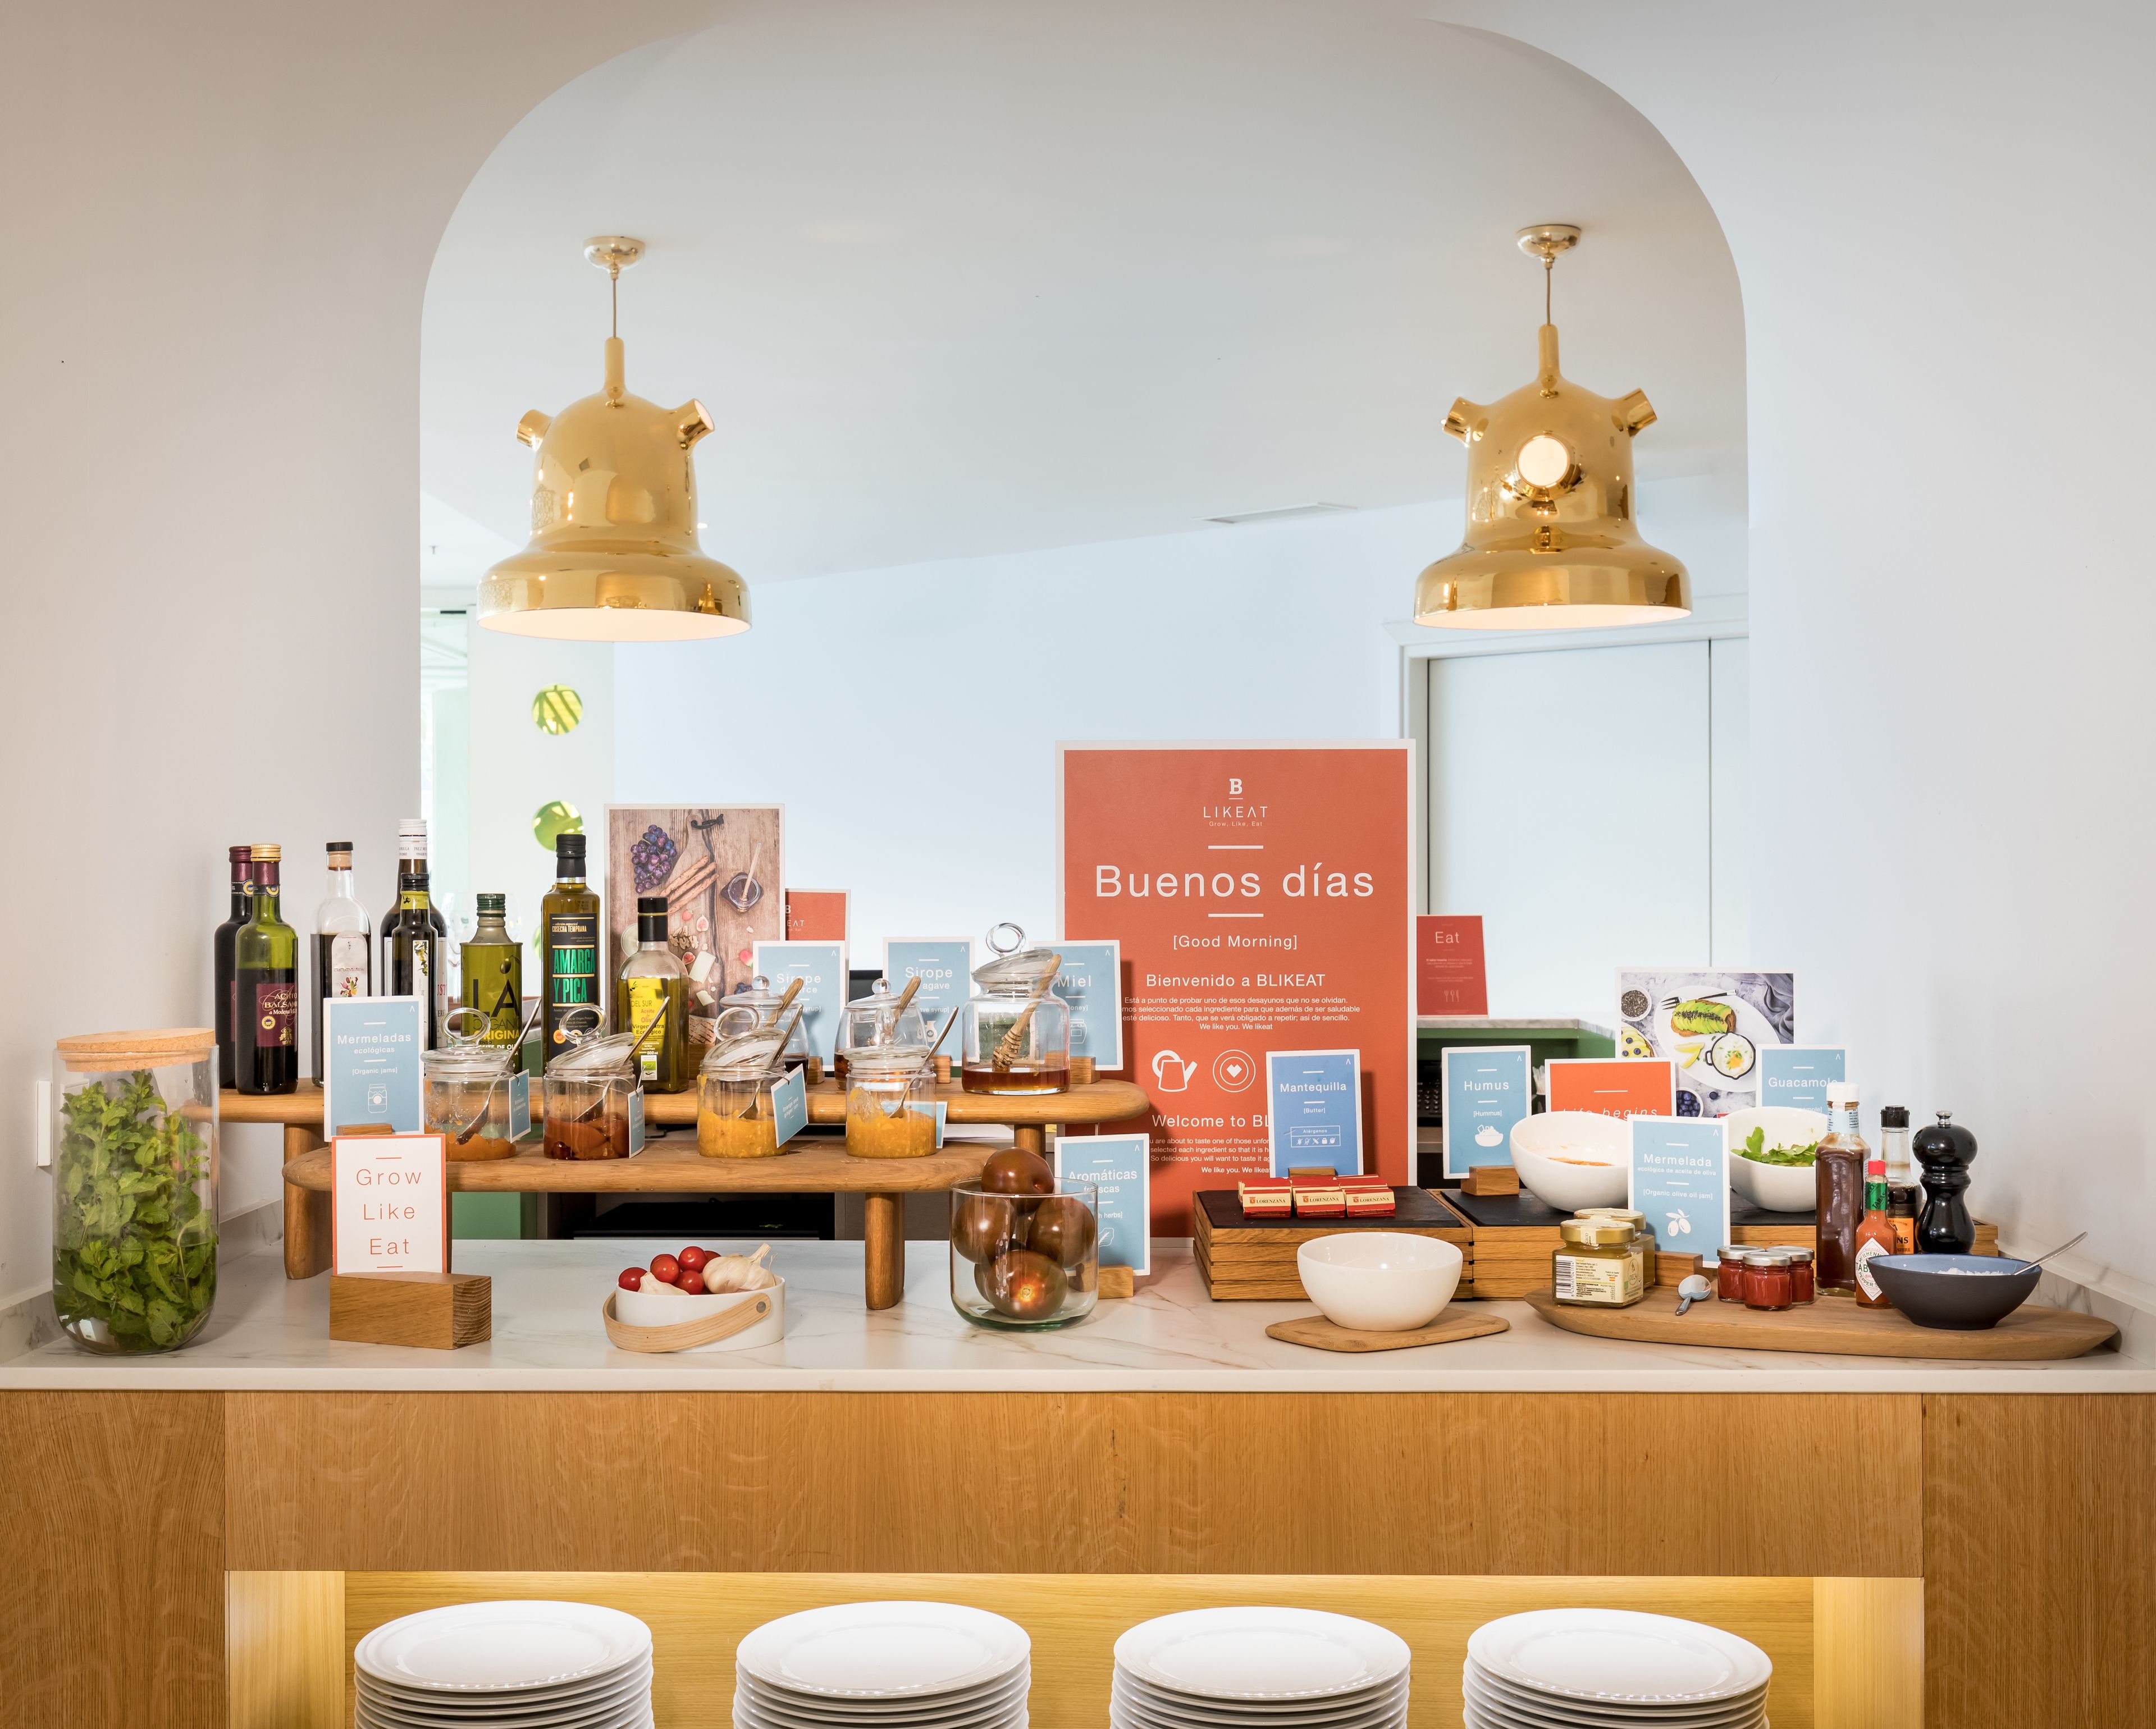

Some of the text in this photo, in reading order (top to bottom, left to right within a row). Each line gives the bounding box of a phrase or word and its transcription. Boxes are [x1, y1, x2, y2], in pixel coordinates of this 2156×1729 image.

[1229, 778, 1243, 795] B
[1096, 862, 1374, 898] Buenos días
[1173, 935, 1297, 950] [Good Morning]
[1435, 931, 1460, 944] Eat
[776, 973, 821, 986] Sirpe
[905, 966, 953, 981] Sirope
[1146, 973, 1326, 987] Bienvenido a BLIKEAT
[922, 982, 950, 991] agave
[1058, 975, 1092, 988] Miel
[553, 978, 587, 1003] Y PICA
[1204, 1005, 1242, 1014] ingrediente
[1236, 1014, 1267, 1023] obligado
[337, 1032, 412, 1045] Mermeladas
[354, 1046, 395, 1055] ecológicas
[352, 1068, 379, 1076] [Organic
[1280, 1082, 1347, 1094] Mantequilla
[1464, 1081, 1509, 1091] Humus
[1473, 1109, 1502, 1118] [Hummus]
[1602, 1106, 1658, 1120] begins
[1152, 1114, 1268, 1127] Welcome to BL
[1643, 1153, 1712, 1168] Mermelada
[356, 1168, 422, 1186] Grow
[1068, 1169, 1138, 1182] Aromáticas
[1643, 1188, 1670, 1197] [Organic
[363, 1203, 415, 1220] Like
[369, 1238, 410, 1255] Eat
[1855, 1262, 1869, 1273] TAB
[1859, 1271, 1874, 1287] PEPPER
